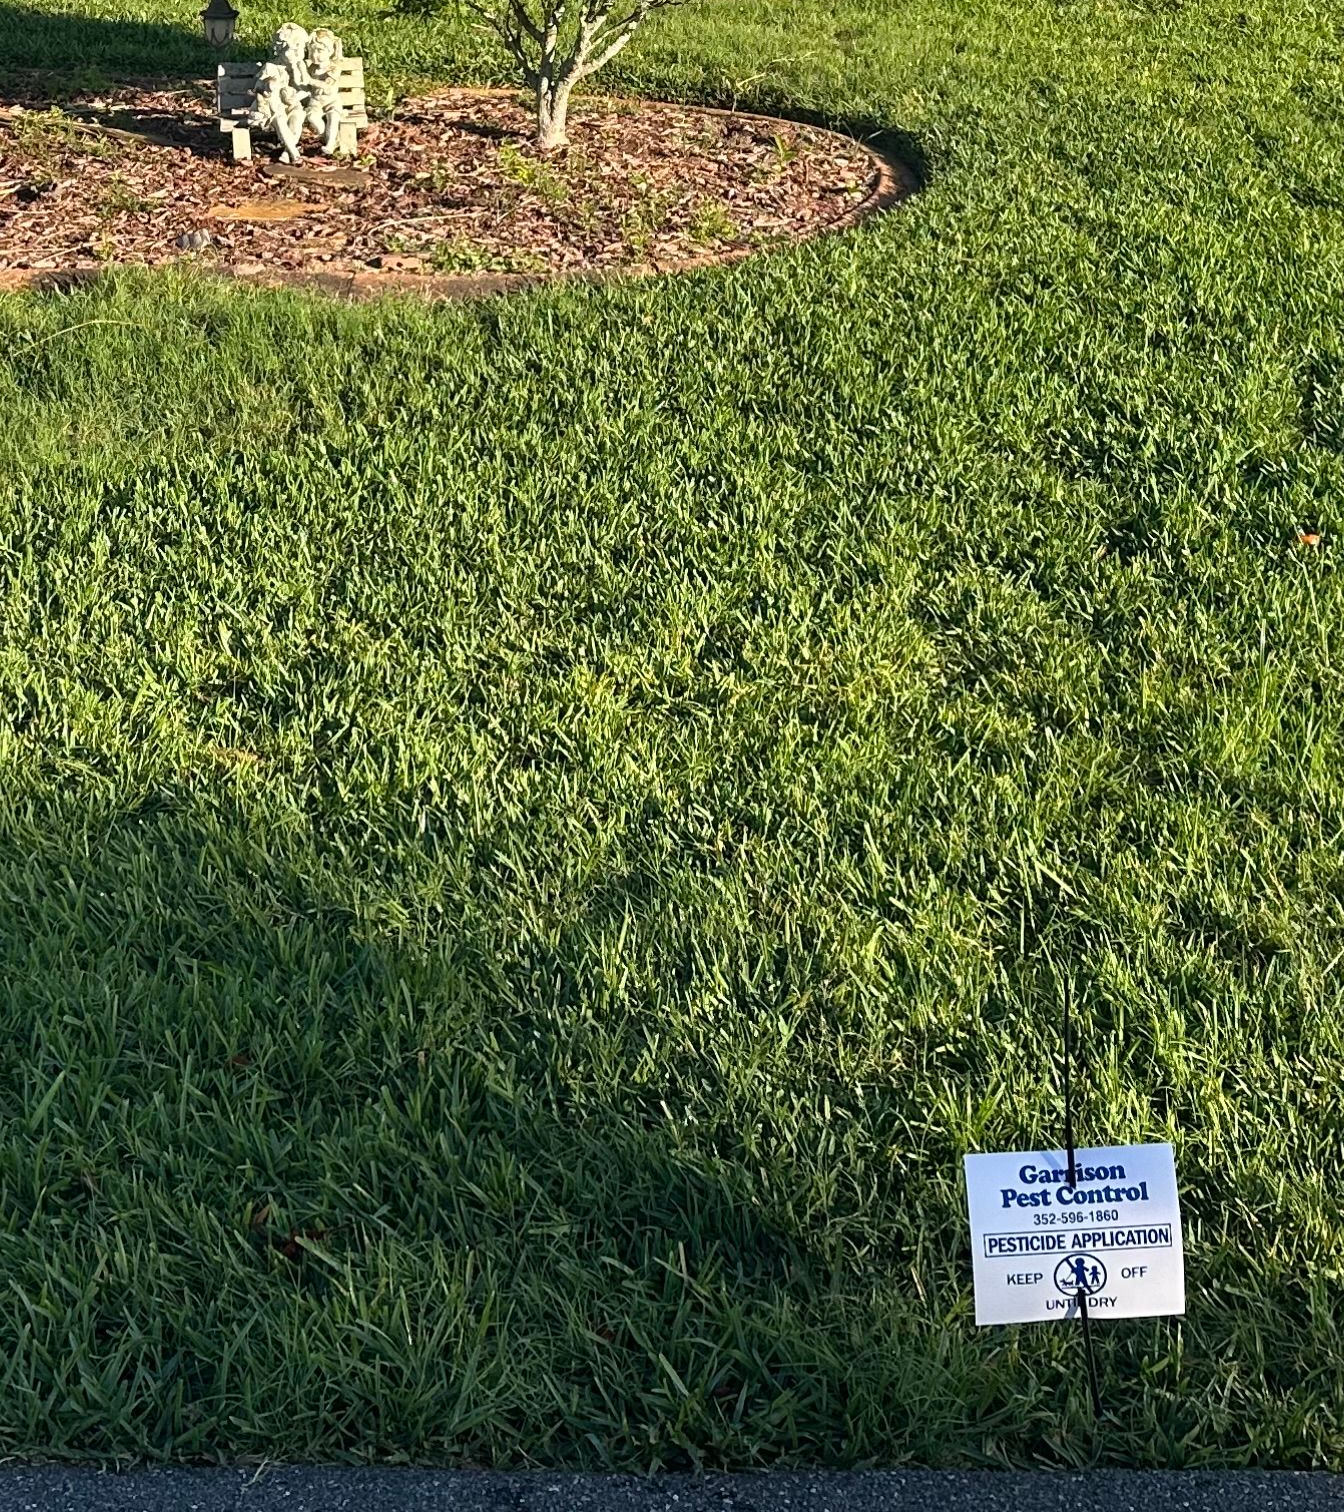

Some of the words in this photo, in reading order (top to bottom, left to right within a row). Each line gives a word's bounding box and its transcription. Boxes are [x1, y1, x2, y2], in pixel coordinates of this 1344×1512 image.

[1000, 1189, 1052, 1208] Pest
[1057, 1182, 1149, 1205] Control
[1033, 1209, 1119, 1226] 352-596-1860
[988, 1234, 1066, 1254] PESTICIDE
[1071, 1227, 1170, 1250] APPLICATION
[1006, 1272, 1044, 1286] KEEP
[1121, 1266, 1148, 1279] OFF
[1046, 1297, 1082, 1310] UNTI
[1088, 1296, 1118, 1308] DRY
